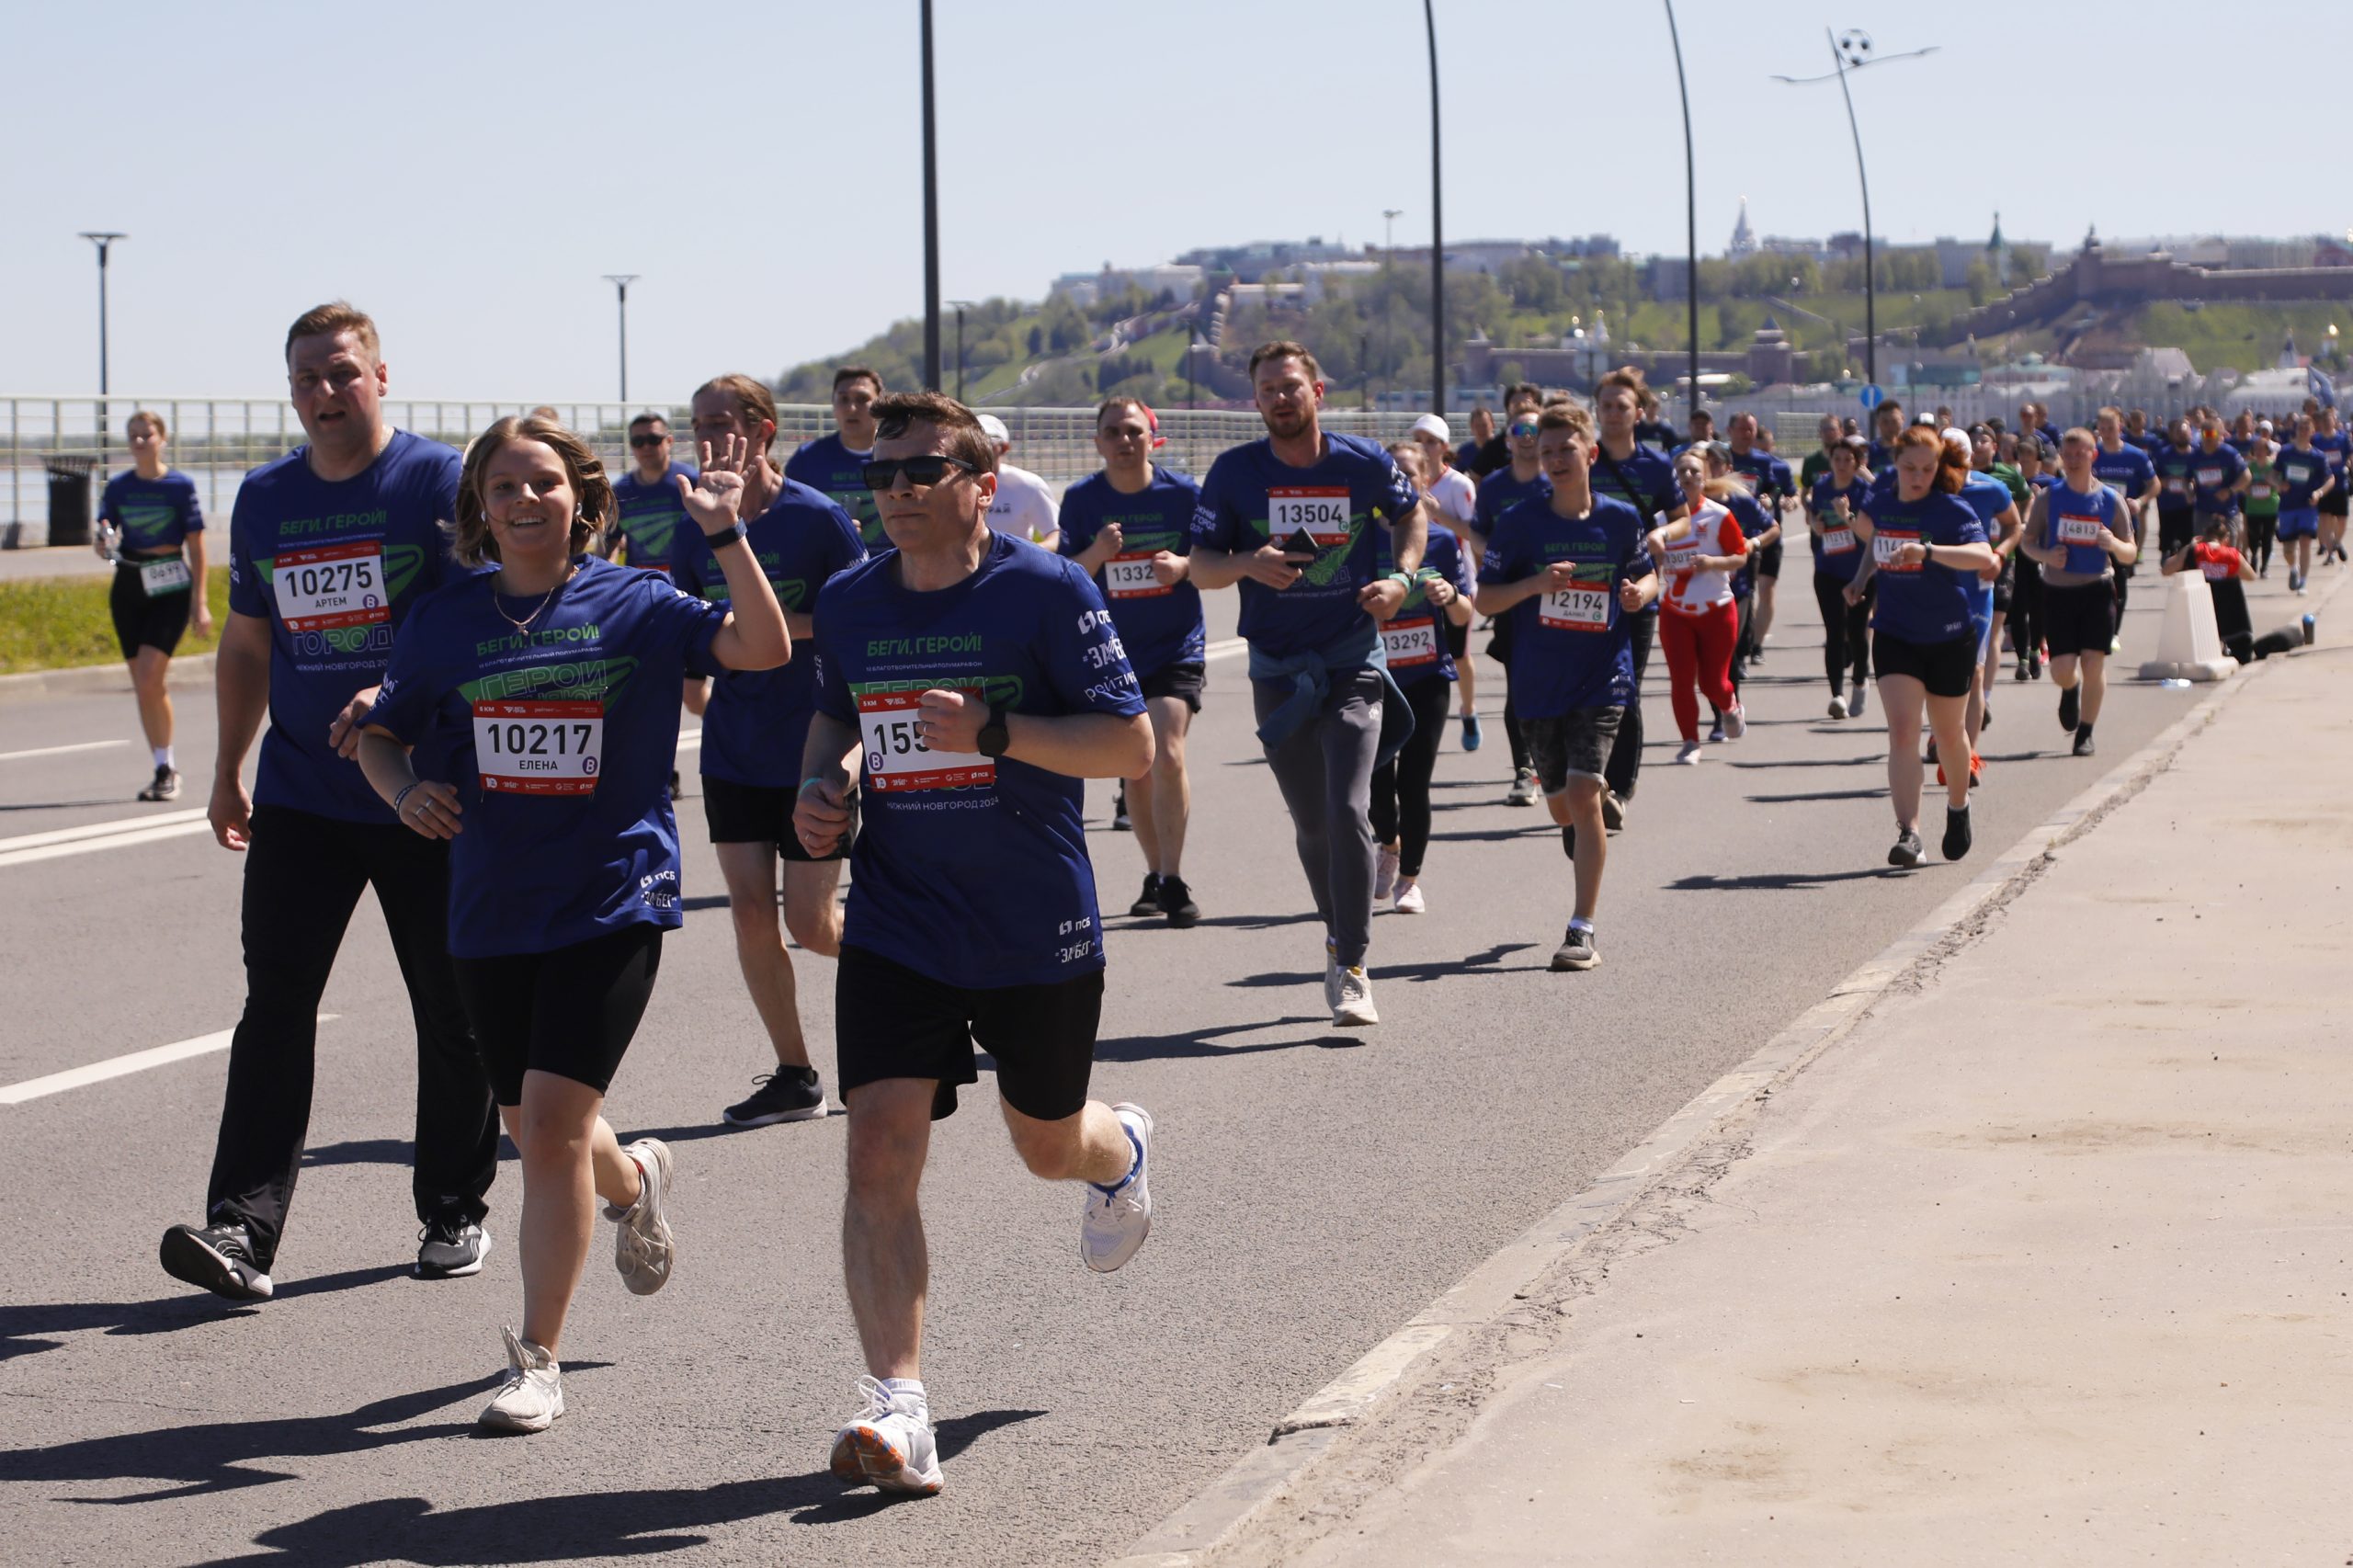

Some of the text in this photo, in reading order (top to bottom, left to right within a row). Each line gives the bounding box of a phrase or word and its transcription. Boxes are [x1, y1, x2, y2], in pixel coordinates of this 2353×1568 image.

[324, 507, 387, 530] ГЕРОЙ!
[1279, 504, 1343, 523] 13504
[285, 562, 372, 597] 10275
[1112, 564, 1154, 582] 1332
[315, 597, 347, 608] АРТЕМ
[1551, 591, 1603, 610] 12194
[291, 624, 394, 655] ГОРОД
[476, 621, 600, 657] БЕГИ, ГЕРОЙ!
[867, 631, 983, 657] БЕГИ, ГЕРОЙ!
[1383, 631, 1429, 651] 13292
[324, 660, 376, 671] НОВГОРОД
[376, 658, 388, 668] 20
[479, 659, 608, 700] ГЕРОИ
[487, 723, 592, 755] 10217
[873, 721, 930, 756] 155
[519, 760, 558, 770] ЕЛЕНА
[923, 800, 979, 811] НОВГОРОД
[979, 795, 1000, 808] 2024
[1075, 915, 1091, 931] ПСБ
